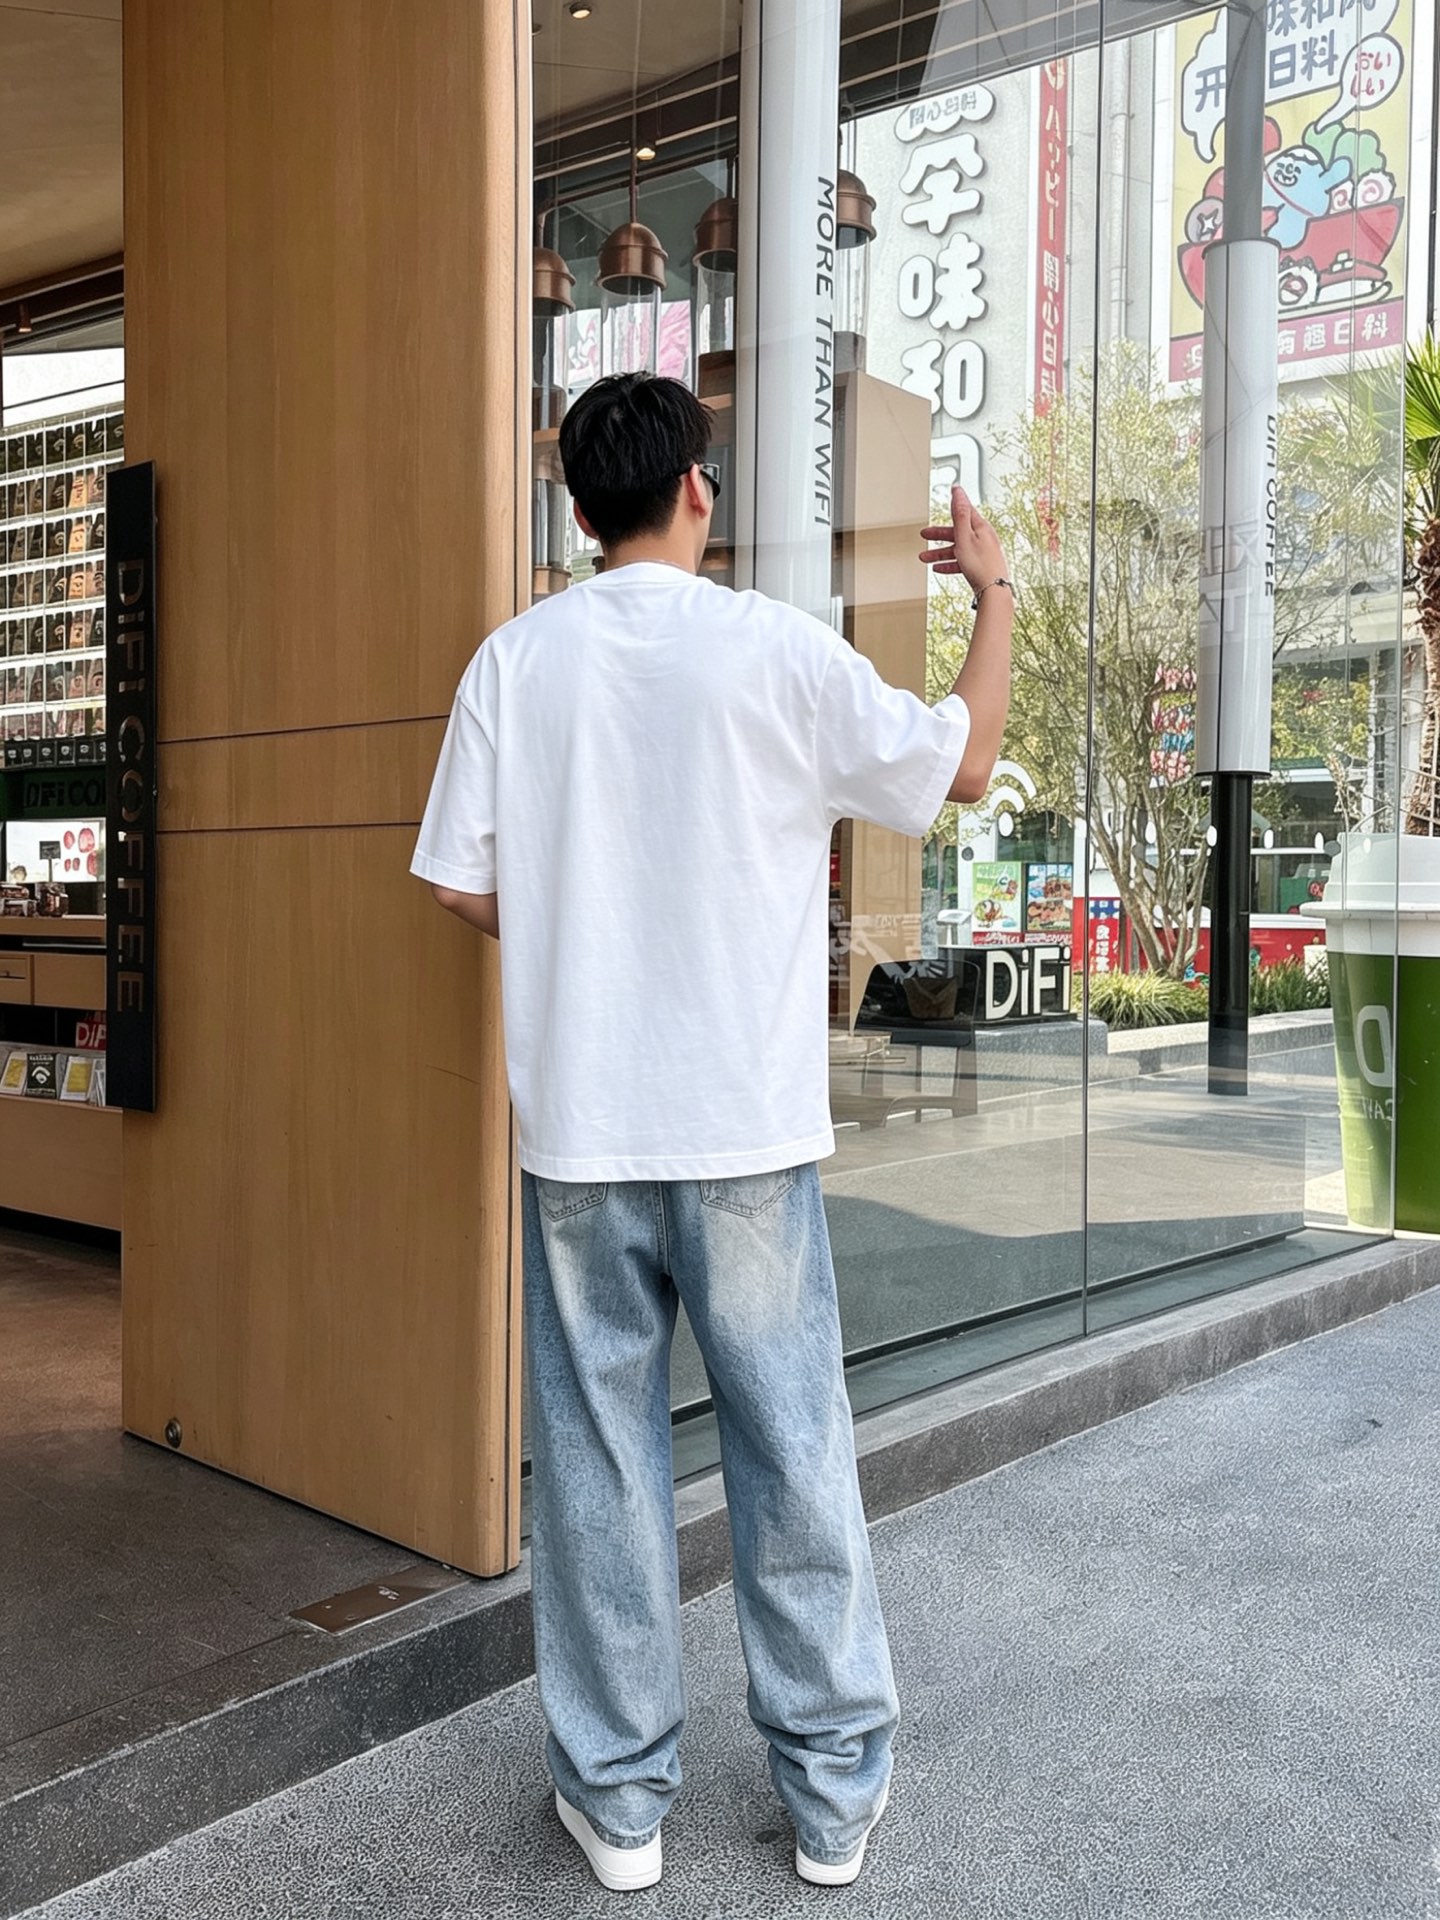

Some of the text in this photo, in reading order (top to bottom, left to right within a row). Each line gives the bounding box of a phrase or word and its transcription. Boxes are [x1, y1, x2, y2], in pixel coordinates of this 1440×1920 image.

[814, 176, 835, 526] MORE THAN WIFI
[117, 559, 146, 1012] DiFi COFFEE
[985, 945, 1071, 1021] DiFi
